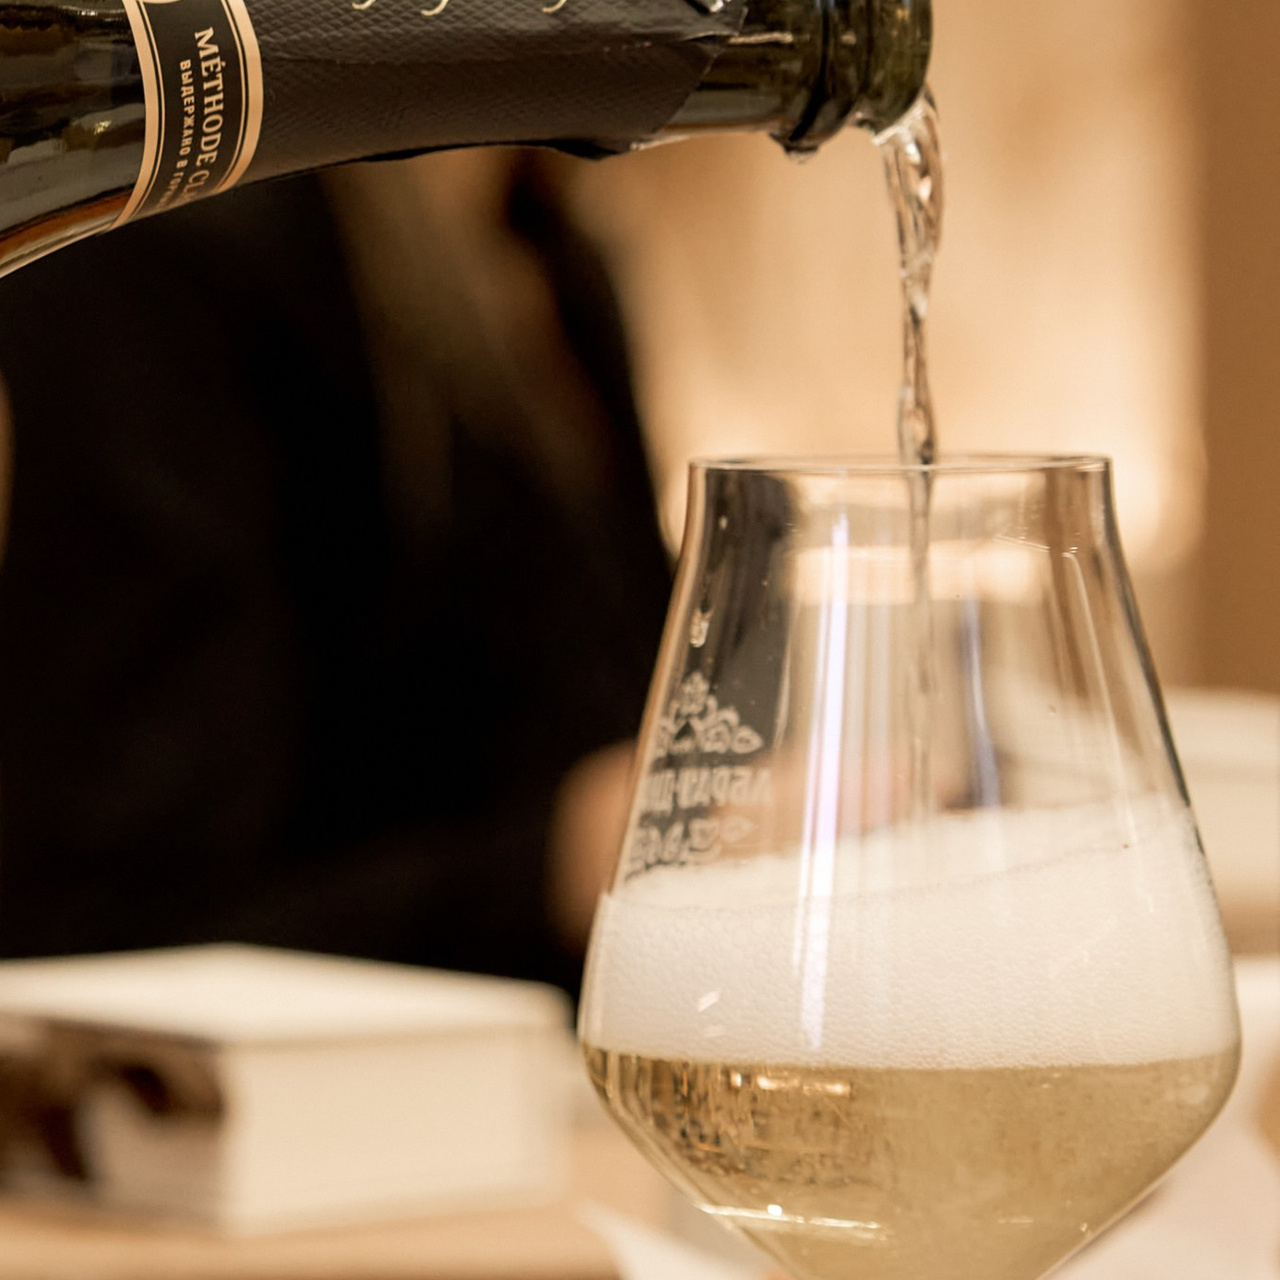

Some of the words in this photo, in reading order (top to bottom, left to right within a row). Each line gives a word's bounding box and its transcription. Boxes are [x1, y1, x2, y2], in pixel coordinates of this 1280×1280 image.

[179, 58, 196, 157] ВЫДЕРЖАНО
[194, 26, 226, 167] MÉTHODE
[176, 159, 189, 169] В
